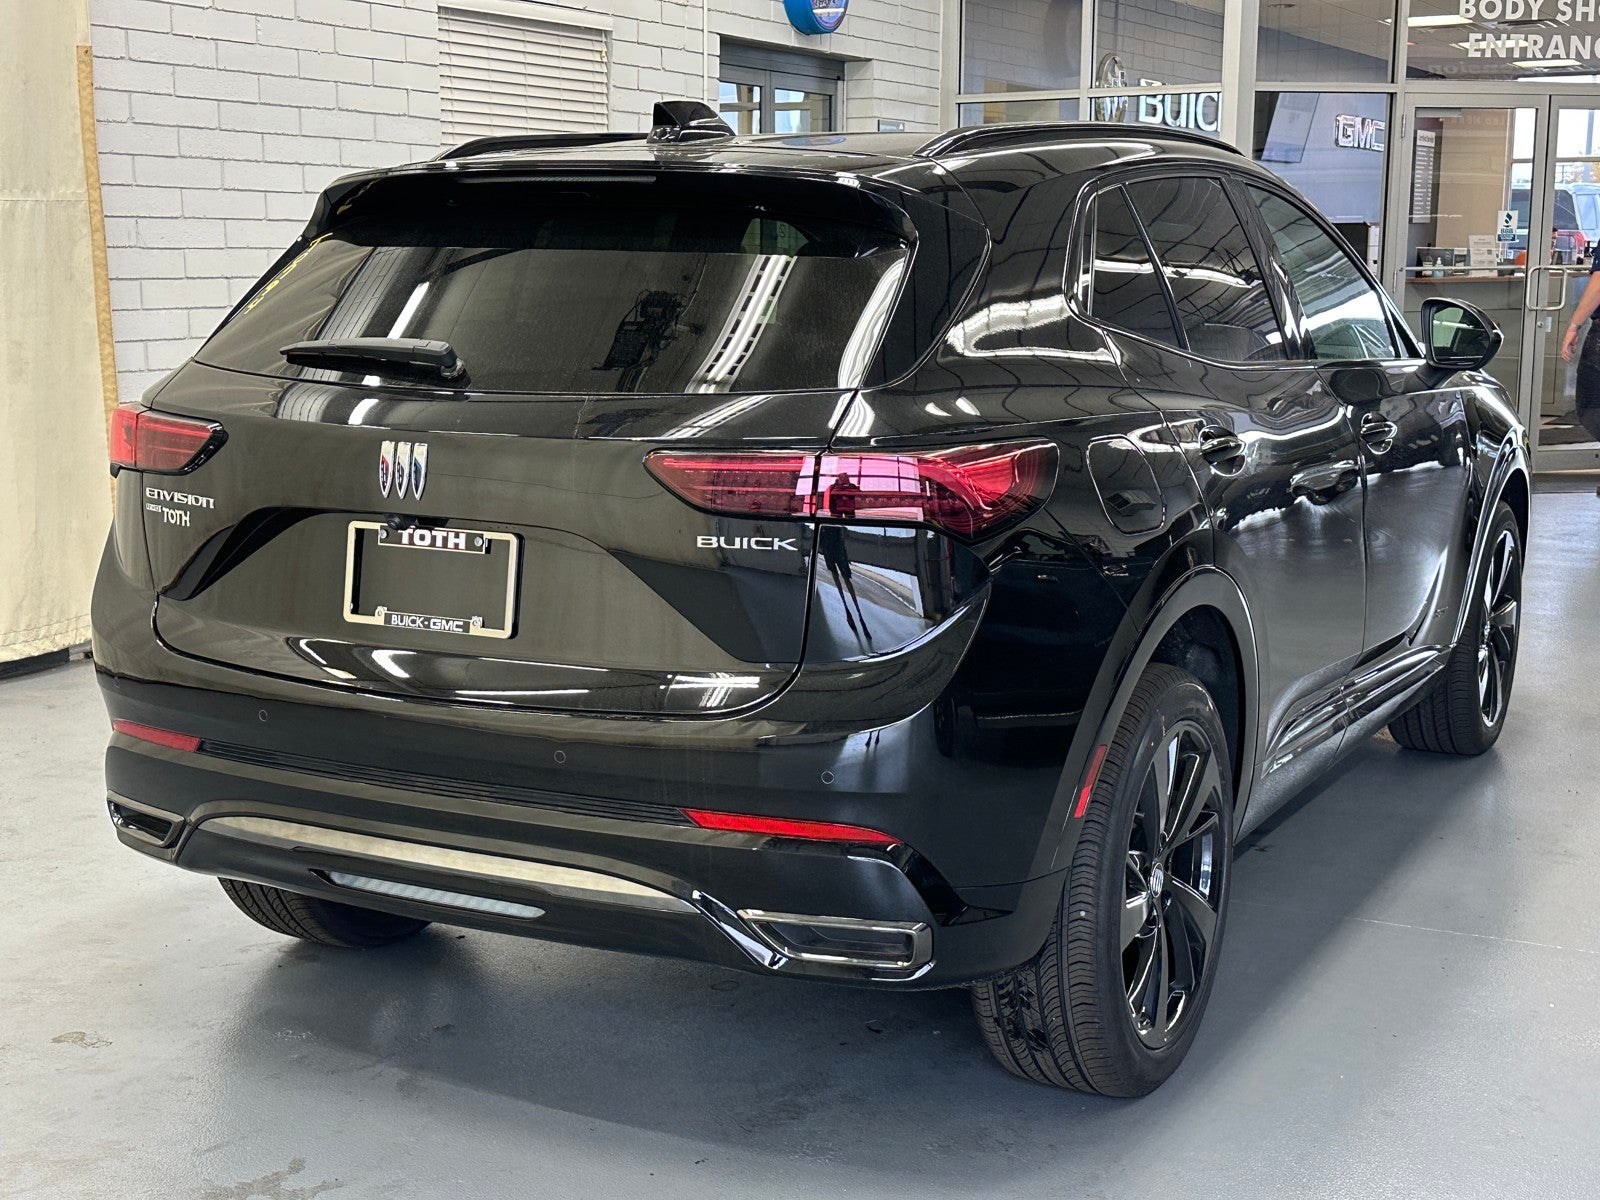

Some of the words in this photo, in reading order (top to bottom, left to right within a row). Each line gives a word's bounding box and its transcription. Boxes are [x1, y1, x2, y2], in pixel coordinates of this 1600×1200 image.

[1459, 0, 1541, 20] BODY
[1555, 0, 1600, 22] SH
[1467, 33, 1600, 59] ENTRAN
[1337, 114, 1385, 152] GMC
[162, 507, 190, 527] TOTH
[398, 528, 466, 550] TOTH
[696, 535, 799, 551] BUICK
